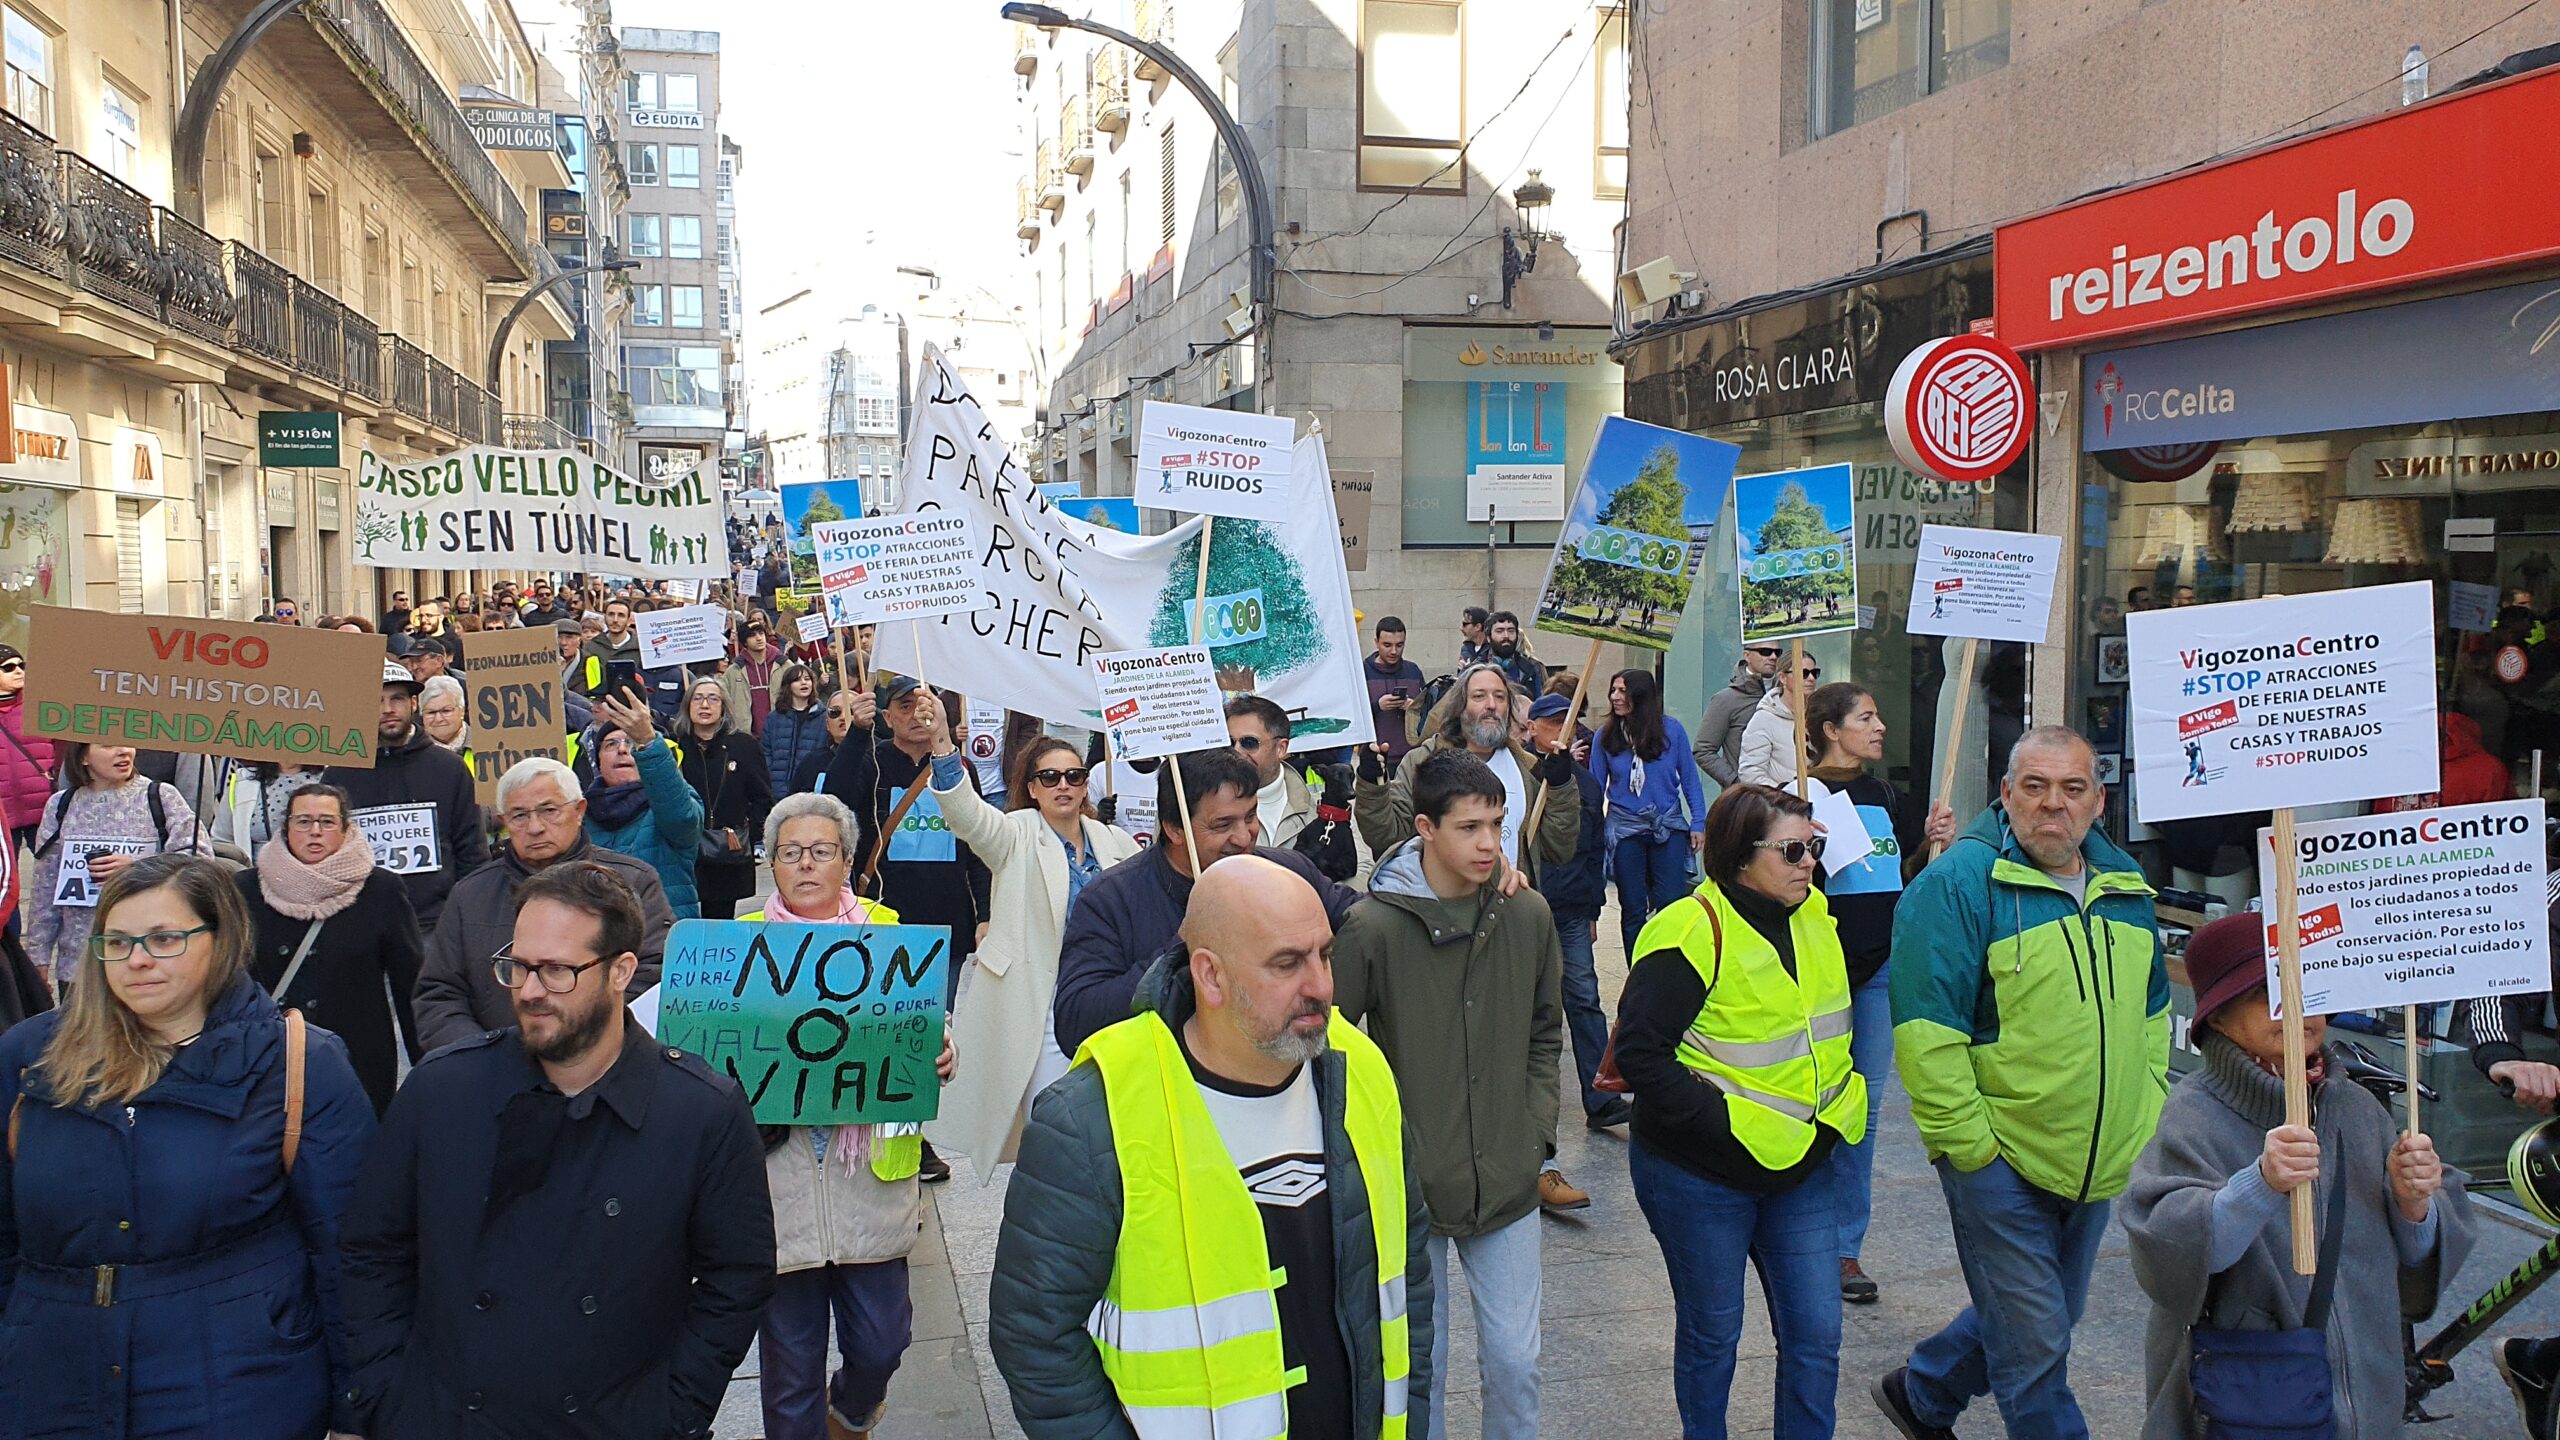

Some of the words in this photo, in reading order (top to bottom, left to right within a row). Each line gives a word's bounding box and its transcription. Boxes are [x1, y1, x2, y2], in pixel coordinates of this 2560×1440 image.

[486, 111, 519, 123] CLINICA
[521, 112, 535, 123] DEL
[538, 113, 551, 124] PIE
[653, 114, 699, 126] EUDITA
[2050, 189, 2414, 320] reizentolo
[1492, 344, 1598, 366] Santander
[1715, 363, 1770, 403] ROSA
[1777, 337, 1854, 391] CLARÁ
[281, 427, 331, 438] VISIÓN
[1167, 427, 1267, 448] VigozonaCentro
[1196, 450, 1260, 470] #STOP
[358, 449, 463, 498] CASCO
[472, 453, 579, 497] VELLO
[1186, 471, 1263, 494] RUIDOS
[439, 509, 514, 553] SEN
[528, 502, 642, 564] TÚNEL
[818, 518, 964, 545] VigozonaCentro
[823, 544, 881, 562] #STOP
[885, 537, 965, 554] ATRACCIONES
[866, 561, 882, 571] DE
[885, 557, 918, 569] FERIA
[921, 550, 974, 565] DELANTE
[1943, 546, 2034, 563] VigozonaCentro
[882, 573, 899, 584] DE
[900, 566, 962, 581] NUESTRAS
[864, 588, 901, 600] CASAS
[904, 586, 912, 595] Y
[912, 579, 975, 594] TRABAJOS
[885, 594, 967, 612] #STOPRUIDOS
[148, 626, 269, 669] VIGO
[2179, 633, 2380, 672] VigozonaCentro
[466, 647, 557, 671] PEONALIZACIÓN
[1097, 652, 1205, 675] VigozonaCentro
[1104, 686, 1127, 695] Siendo
[1128, 684, 1145, 692] estos
[1146, 682, 1170, 692] jardines
[1172, 678, 1202, 688] propiedad
[1114, 674, 1145, 684] JARDINES
[1165, 669, 1195, 678] ALAMEDA
[2182, 670, 2262, 697] #STOP
[2266, 660, 2377, 685] ATRACCIONES
[92, 669, 159, 697] TEN
[170, 677, 325, 712] HISTORIA
[1150, 691, 1185, 700] ciudadanos
[2239, 694, 2260, 709] DE
[2263, 690, 2310, 706] FERIA
[2313, 680, 2387, 702] DELANTE
[478, 681, 552, 730] SEN
[1168, 700, 1192, 708] interesa
[1181, 710, 1192, 718] Por
[2186, 706, 2222, 727] #Vigo
[2258, 713, 2279, 727] DE
[2283, 704, 2367, 725] NUESTRAS
[38, 701, 368, 759] DEFENDÁMOLA
[1124, 728, 1141, 736] pone
[1142, 725, 1157, 735] bajo
[1166, 721, 1190, 730] especial
[1191, 718, 1214, 727] cuidado
[1162, 732, 1191, 742] vigilancia
[2179, 725, 2211, 740] Somos
[2230, 729, 2282, 750] CASAS
[2286, 730, 2298, 744] Y
[2299, 722, 2382, 743] TRABAJOS
[2255, 744, 2368, 768] #STOPRUIDOS
[358, 812, 419, 828] EMBRIVE
[382, 827, 431, 842] QUERE
[63, 860, 85, 870] NO
[2298, 859, 2369, 878] JARDINES
[2372, 857, 2393, 870] DE
[2396, 854, 2416, 868] LA
[2420, 846, 2495, 865] ALAMEDA
[2327, 876, 2365, 893] estos
[2368, 873, 2428, 891] jardines
[2432, 865, 2510, 884] propiedad
[2513, 862, 2533, 875] de
[58, 878, 99, 900] A-
[2350, 897, 2371, 909] los
[2374, 889, 2460, 907] ciudadanos
[2463, 888, 2472, 897] a
[2475, 882, 2519, 896] todos
[2374, 911, 2409, 927] ellos
[2412, 906, 2472, 924] interesa
[2475, 905, 2492, 916] su
[2336, 928, 2438, 949] conservación.
[2440, 925, 2466, 938] Por
[2469, 922, 2500, 935] esto
[2503, 919, 2526, 932] los
[676, 947, 737, 966] MAIS
[732, 931, 945, 1002] NÓN
[2302, 959, 2338, 975] pone
[2342, 951, 2374, 969] bajo
[2377, 951, 2394, 963] su
[2397, 944, 2457, 963] especial
[2460, 938, 2520, 955] cuidado
[2523, 938, 2533, 952] y
[669, 970, 734, 989] RURAL
[2384, 964, 2455, 984] vigilancia
[2488, 979, 2498, 988] El
[2498, 976, 2531, 987] alcalde
[871, 1002, 886, 1016] O
[894, 996, 938, 1016] RURAL
[664, 1024, 780, 1062] VIAL
[786, 1004, 861, 1062] Ó
[726, 1056, 913, 1120] VIAL
